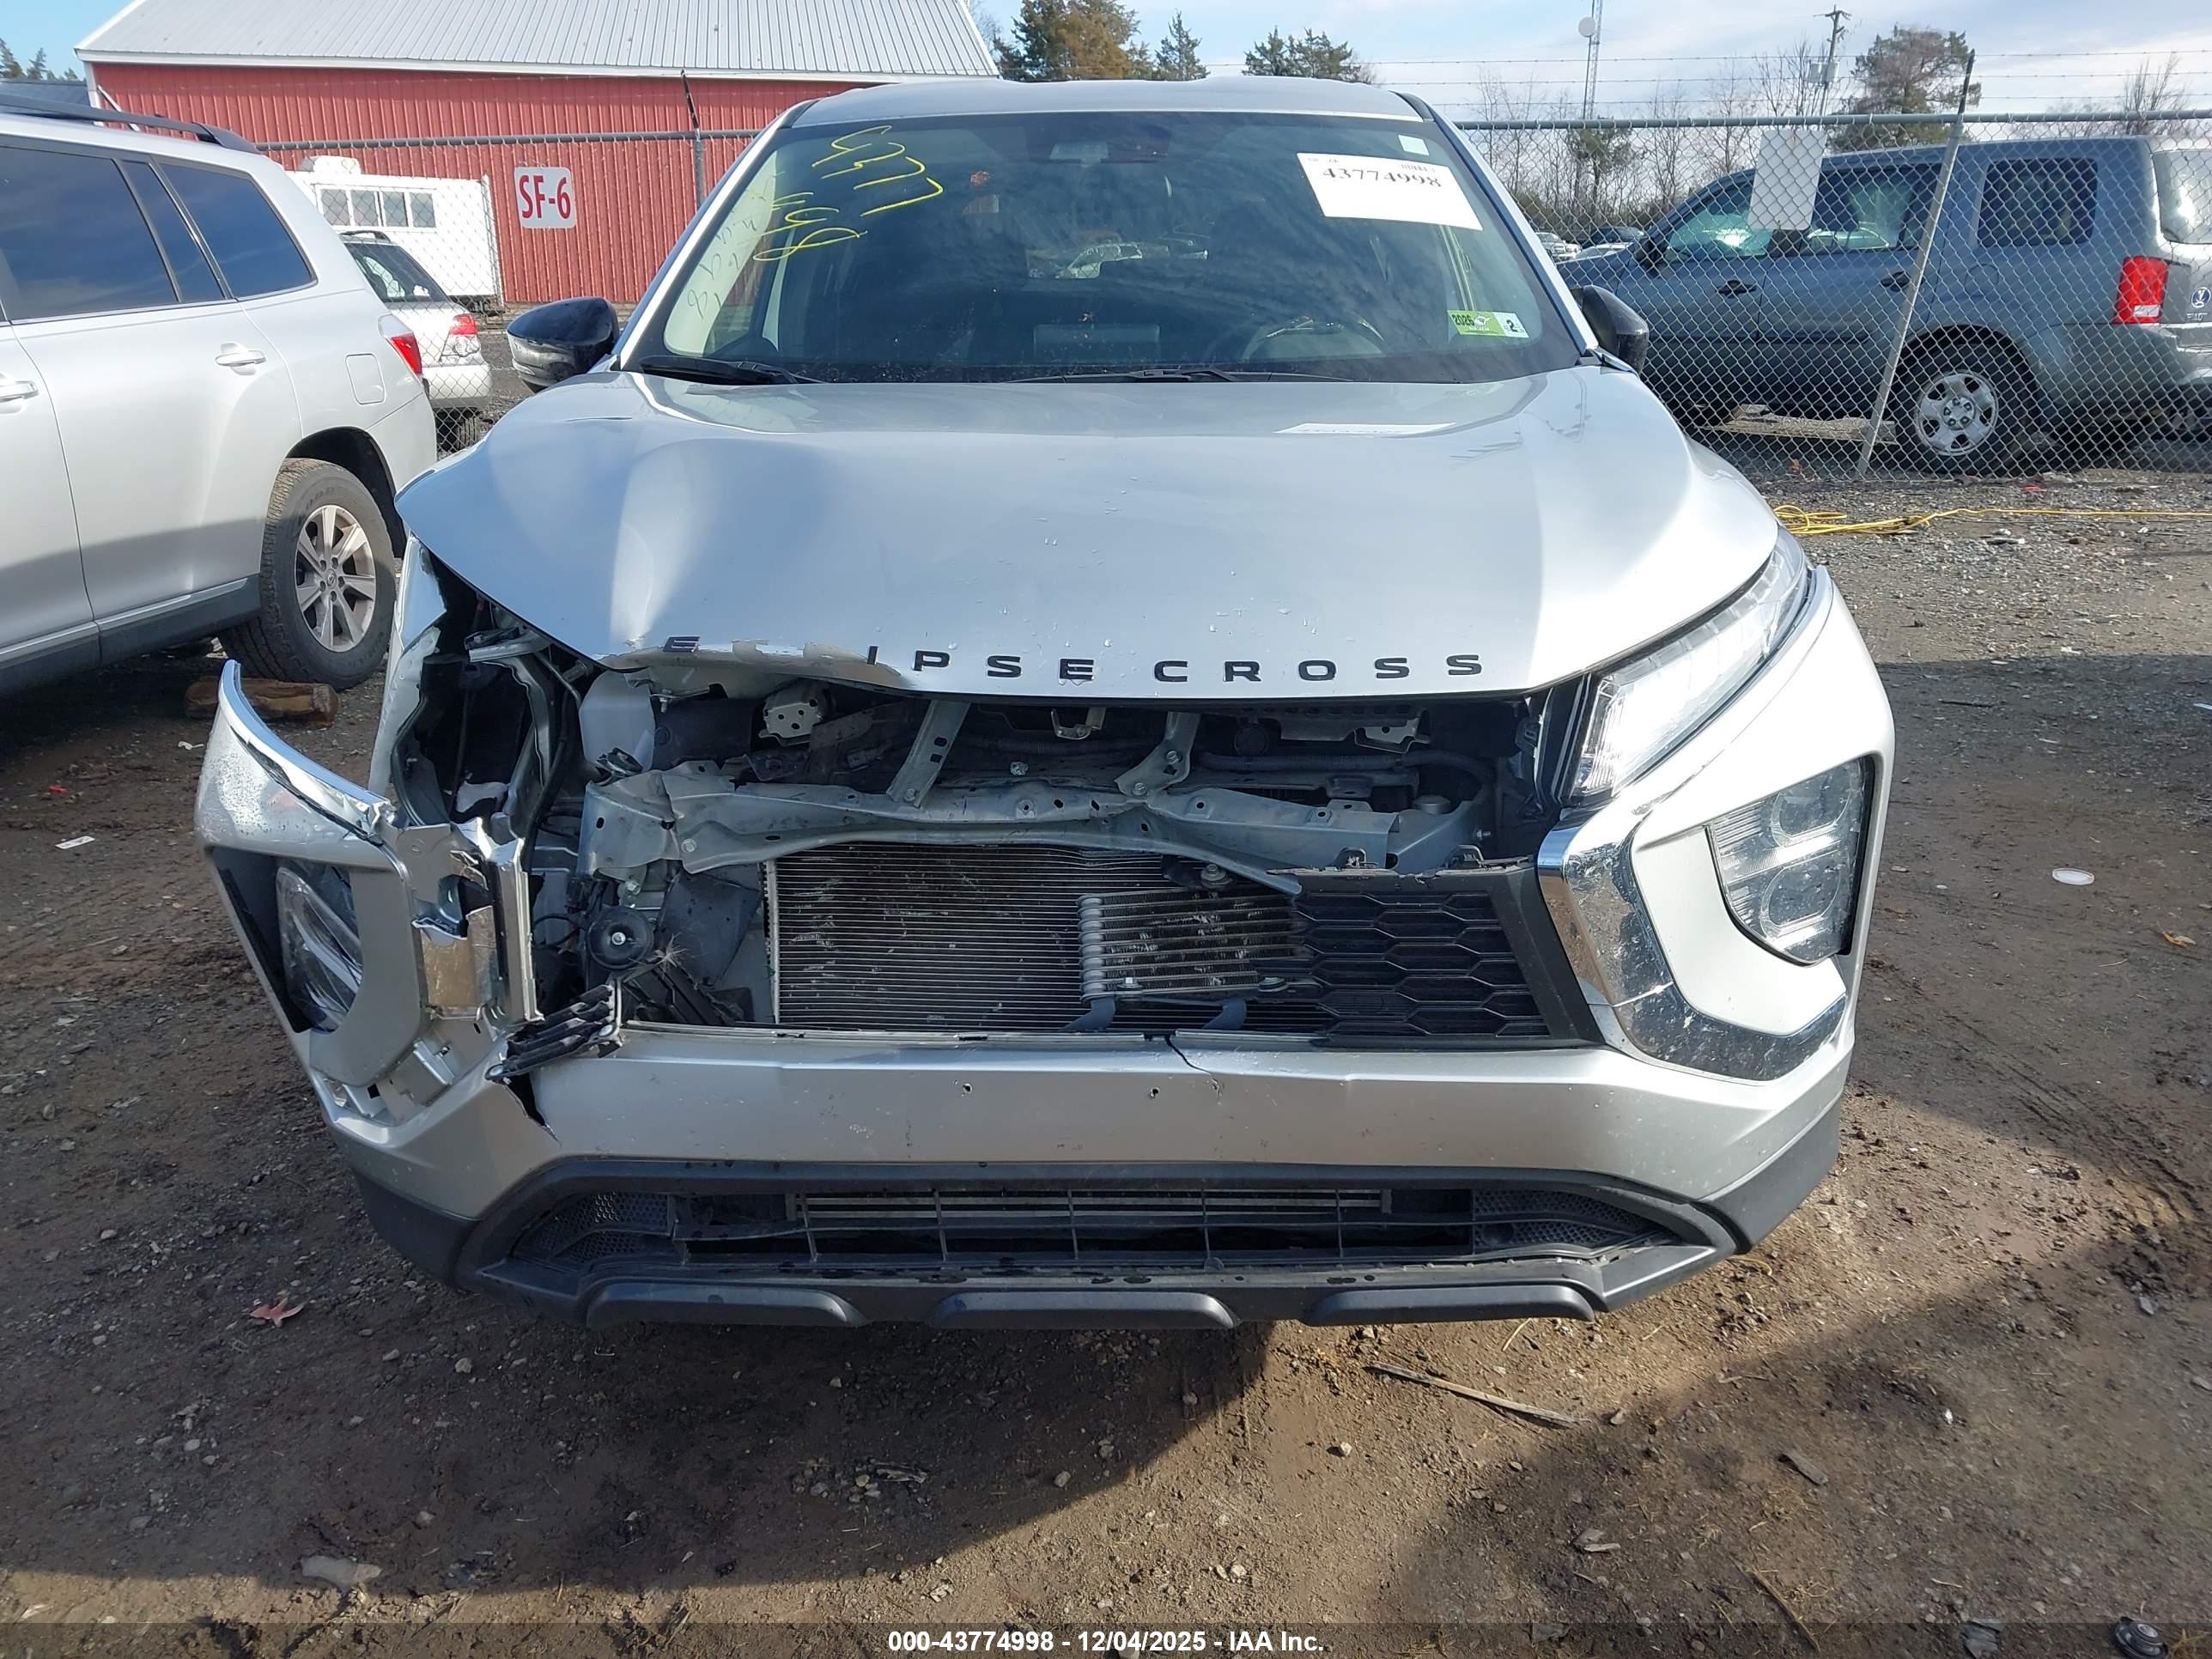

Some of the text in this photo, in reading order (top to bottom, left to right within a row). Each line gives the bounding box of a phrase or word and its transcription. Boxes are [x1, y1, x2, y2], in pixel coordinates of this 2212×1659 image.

[1322, 167, 1443, 188] 43774998
[519, 174, 571, 219] SF-6
[1451, 313, 1475, 327] 2026
[1506, 319, 1518, 333] 2
[1153, 653, 1483, 684] CROSS
